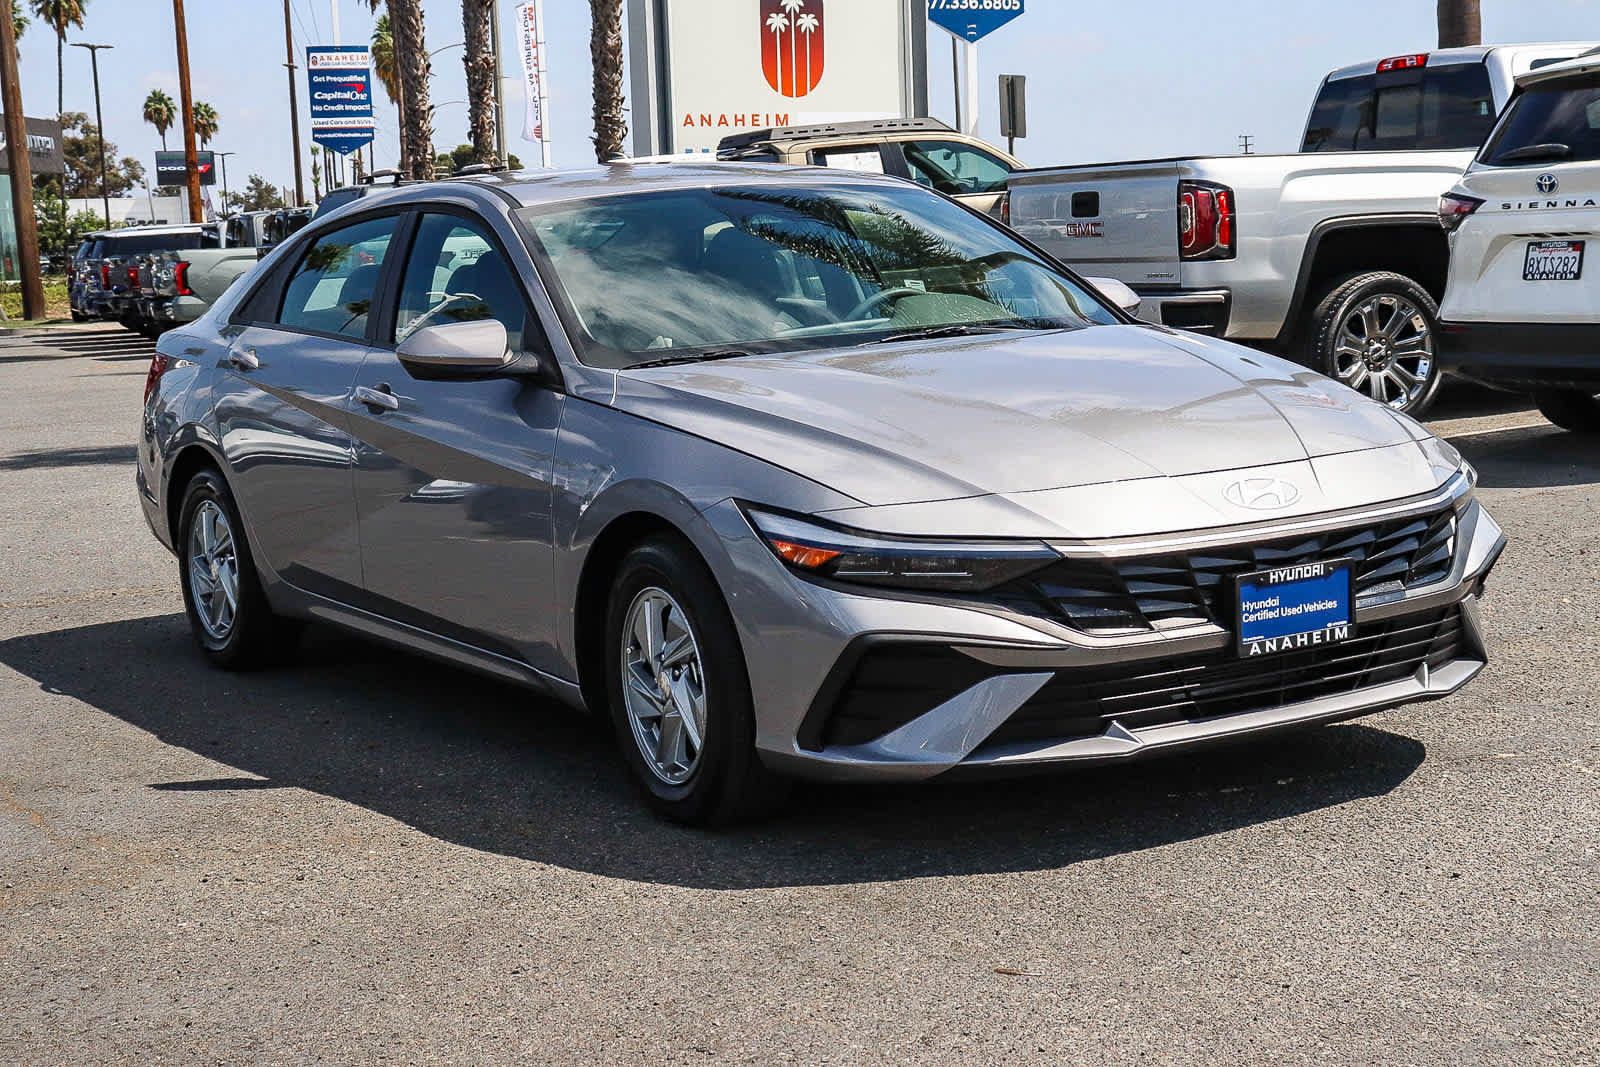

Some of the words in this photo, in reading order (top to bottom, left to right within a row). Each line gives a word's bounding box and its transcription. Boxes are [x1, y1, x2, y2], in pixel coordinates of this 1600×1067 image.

[928, 0, 1021, 10] 77.336.6805
[683, 113, 789, 127] ANAHEIM
[1502, 199, 1596, 210] SIENNA
[1066, 221, 1104, 237] GMC
[1527, 272, 1574, 280] ANAHEIM
[1269, 563, 1324, 584] HYUNDAI
[1242, 595, 1280, 612] Hyundai
[1242, 608, 1280, 623] Certified
[1280, 604, 1302, 617] Used
[1303, 600, 1338, 613] Vehicles
[1249, 626, 1348, 656] ANAHEIM
